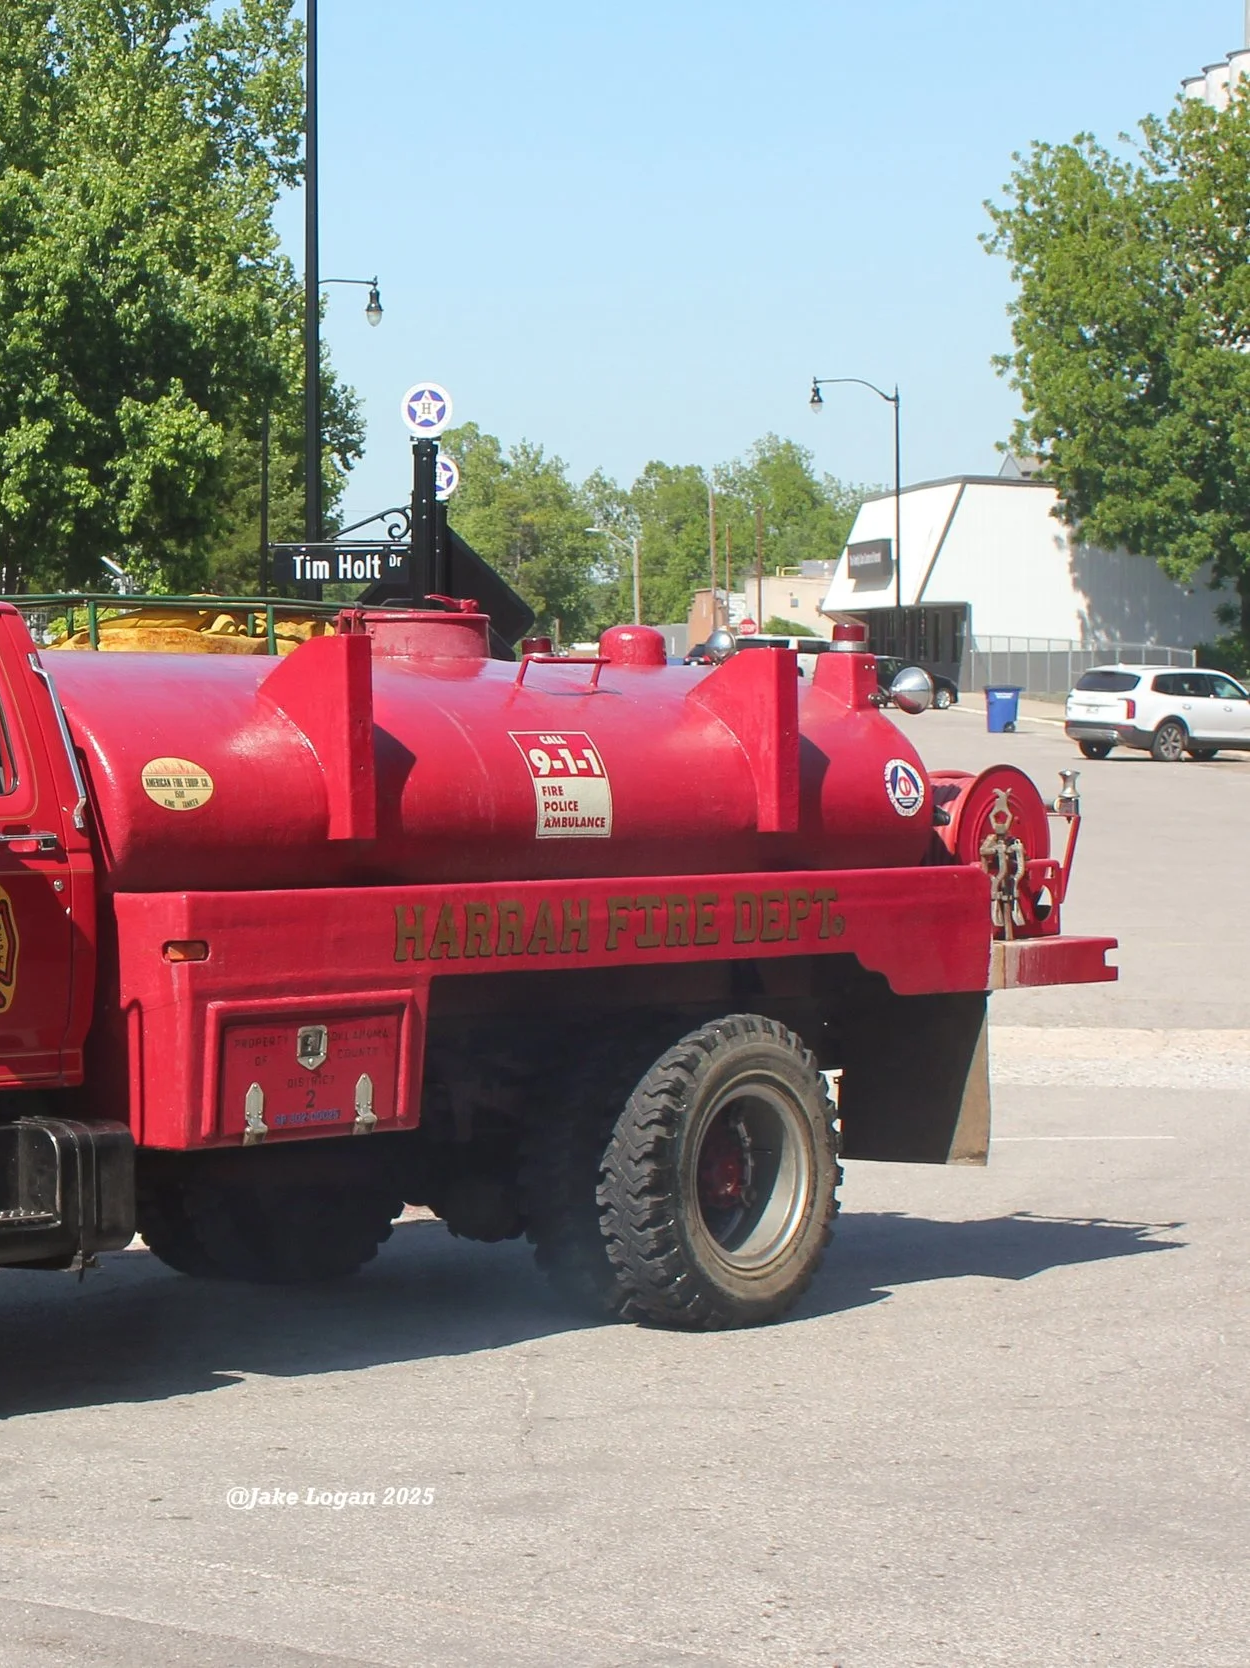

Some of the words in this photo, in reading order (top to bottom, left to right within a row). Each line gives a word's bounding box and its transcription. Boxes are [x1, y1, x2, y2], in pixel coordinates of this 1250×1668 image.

[292, 555, 329, 579] Tim
[338, 554, 381, 579] Holt
[389, 554, 402, 567] Dr
[538, 735, 567, 745] CALL
[528, 748, 602, 775] 9-1-1
[145, 778, 171, 787] AMERICAN
[172, 778, 183, 787] FIRE
[541, 785, 564, 796] FIRE
[164, 798, 175, 808] KING
[544, 801, 578, 812] POLICE
[544, 817, 606, 828] AMBULANCE
[394, 900, 589, 962] HARRAH
[605, 892, 719, 950] FIRE
[732, 888, 846, 944] DEPT.
[234, 1036, 288, 1048] PROPERTY
[255, 1055, 268, 1066] OF
[287, 1074, 335, 1088] DISTRICT
[305, 1090, 316, 1108] 2
